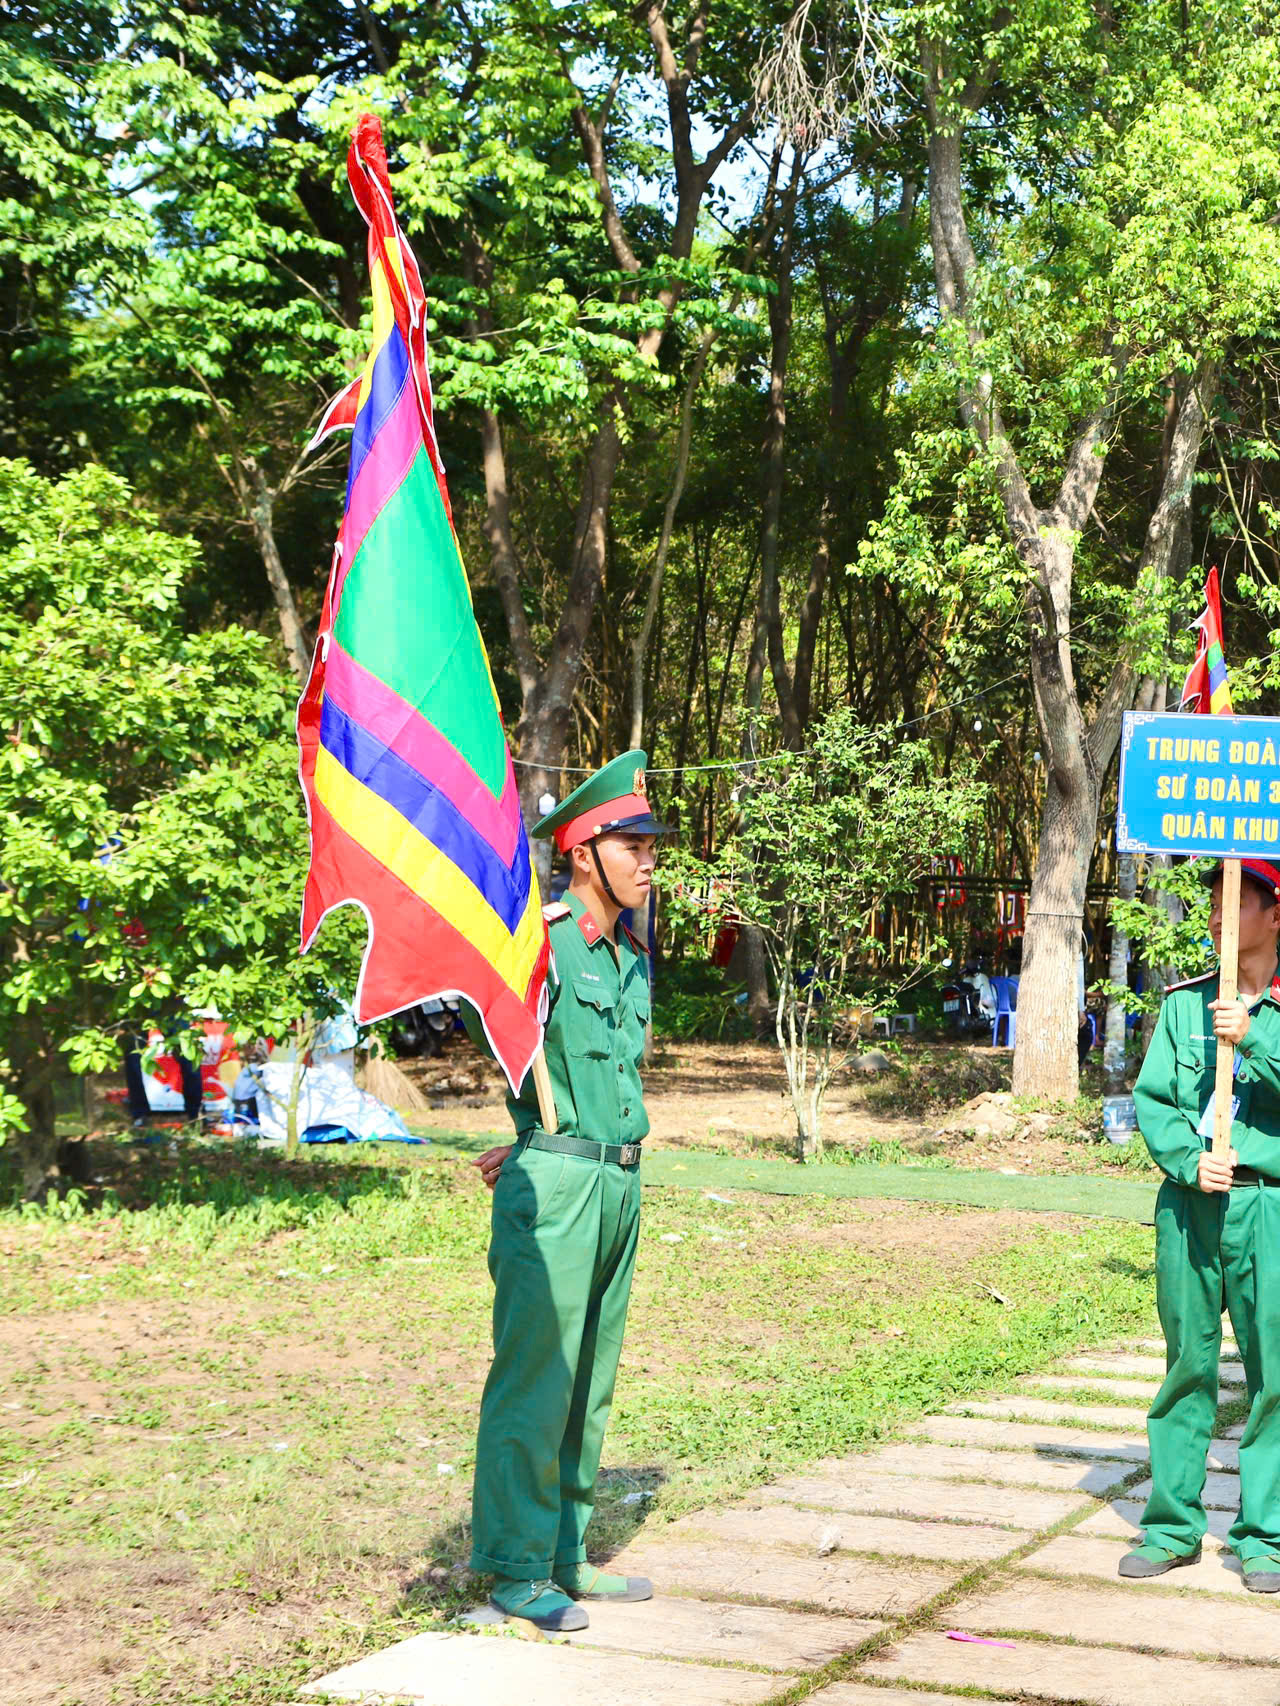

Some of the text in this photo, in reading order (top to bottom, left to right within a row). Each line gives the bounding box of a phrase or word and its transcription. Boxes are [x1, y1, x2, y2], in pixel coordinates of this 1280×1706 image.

[1146, 737, 1220, 763] TRUNG
[1156, 773, 1188, 800] SƯ
[1195, 774, 1261, 803] ĐOÀN
[1161, 811, 1226, 840] QUÂN
[1233, 817, 1279, 842] KHU
